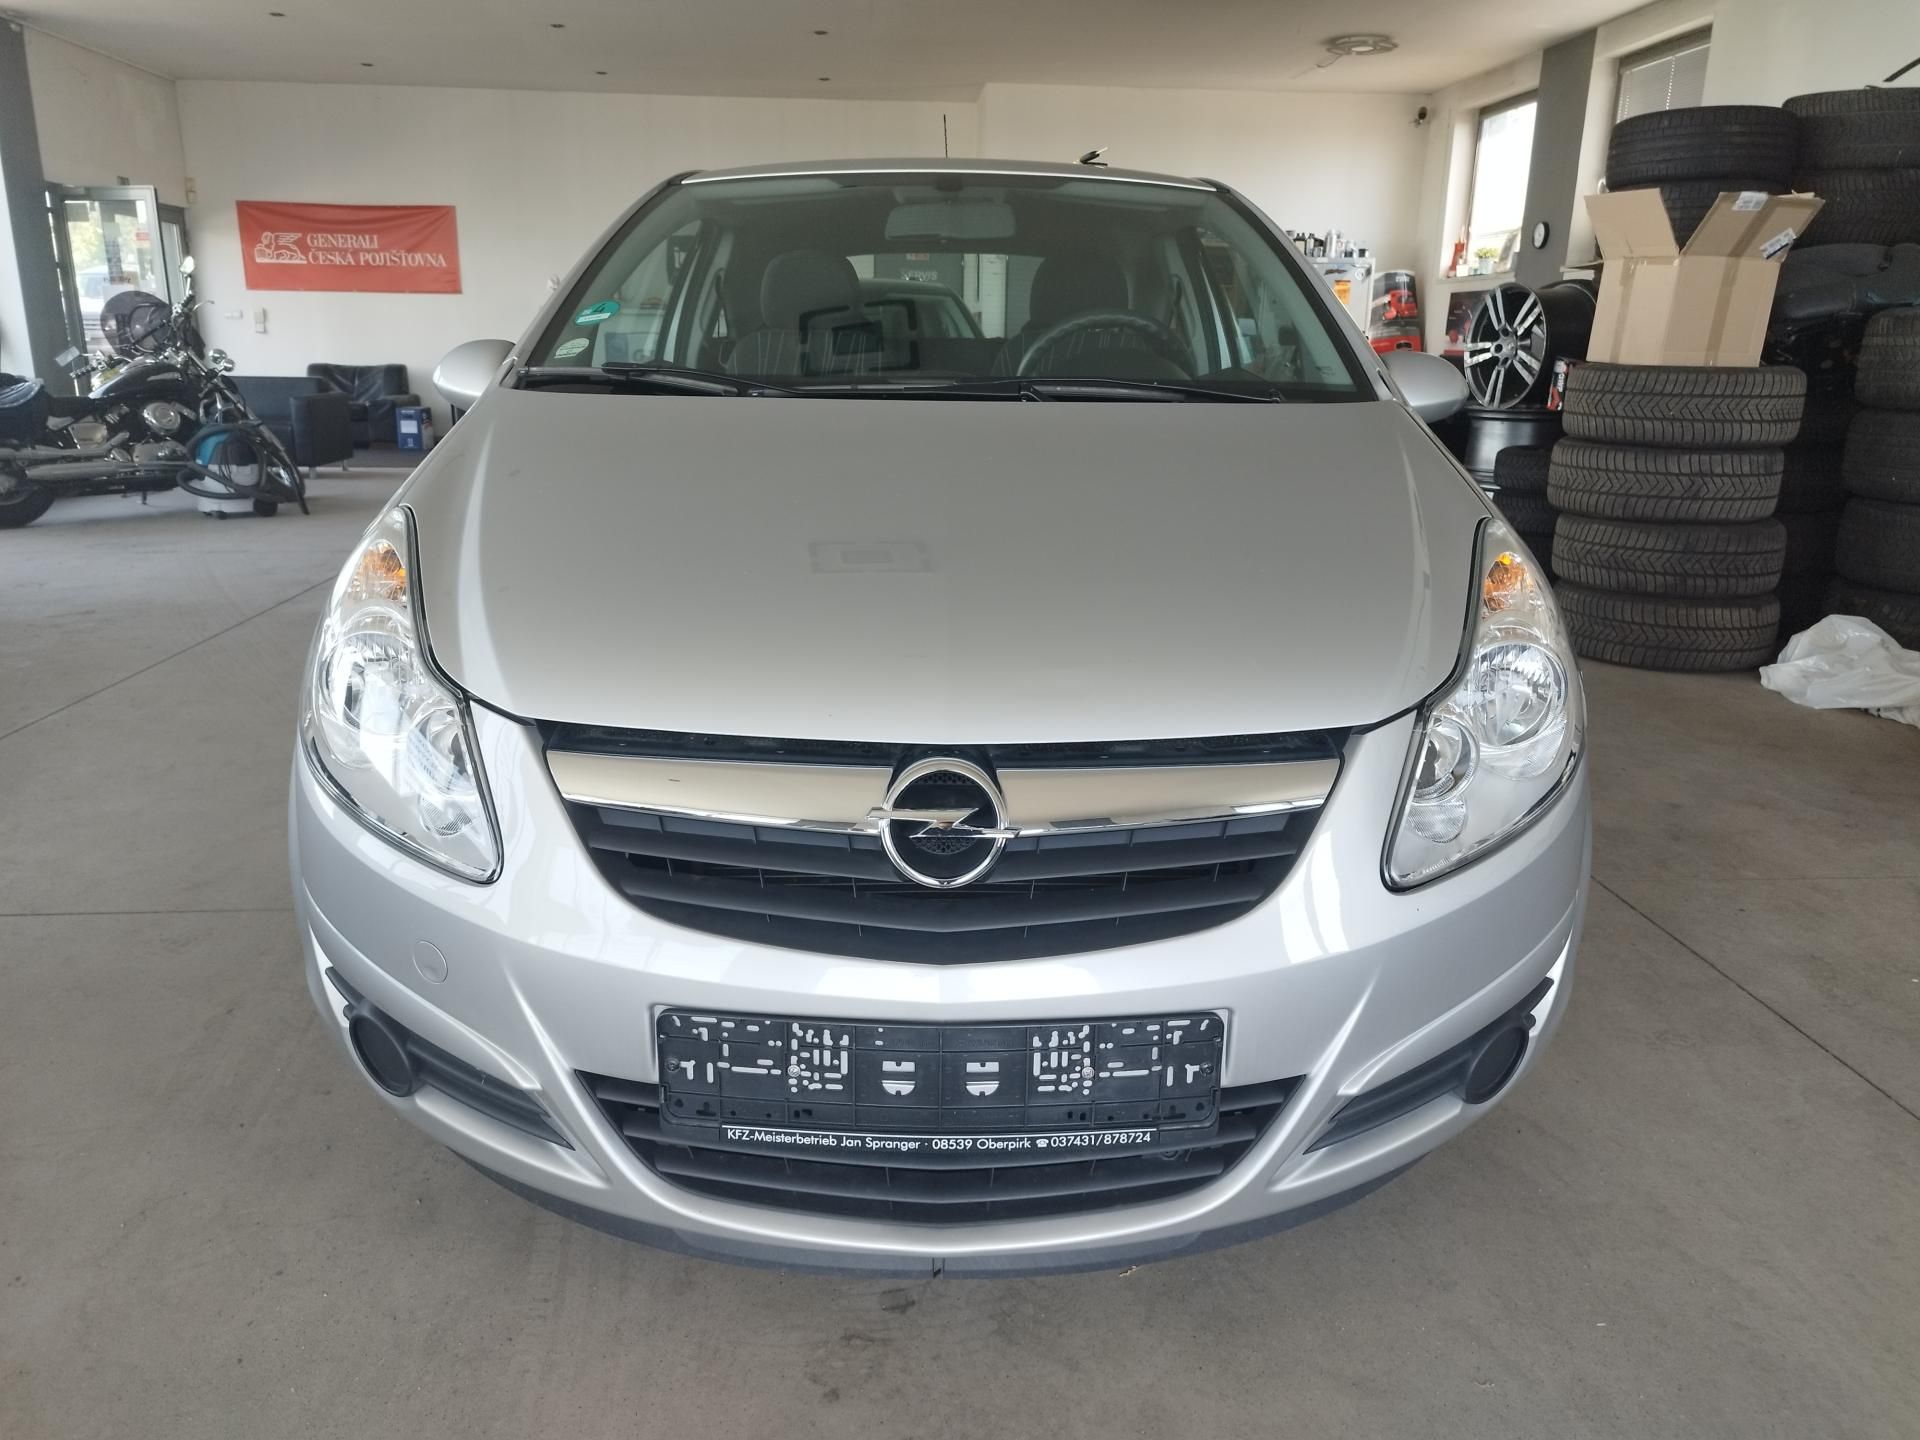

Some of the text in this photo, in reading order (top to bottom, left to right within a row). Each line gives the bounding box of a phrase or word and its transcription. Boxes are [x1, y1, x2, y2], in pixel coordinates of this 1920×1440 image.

[307, 233, 378, 249] GENERALI
[308, 248, 447, 267] ČESKÁ POJIŠŤOVNA
[727, 1128, 1151, 1152] KFZ-Meisterbetrieb Jan Spranger 08539 Oberpirk 037431/878724
